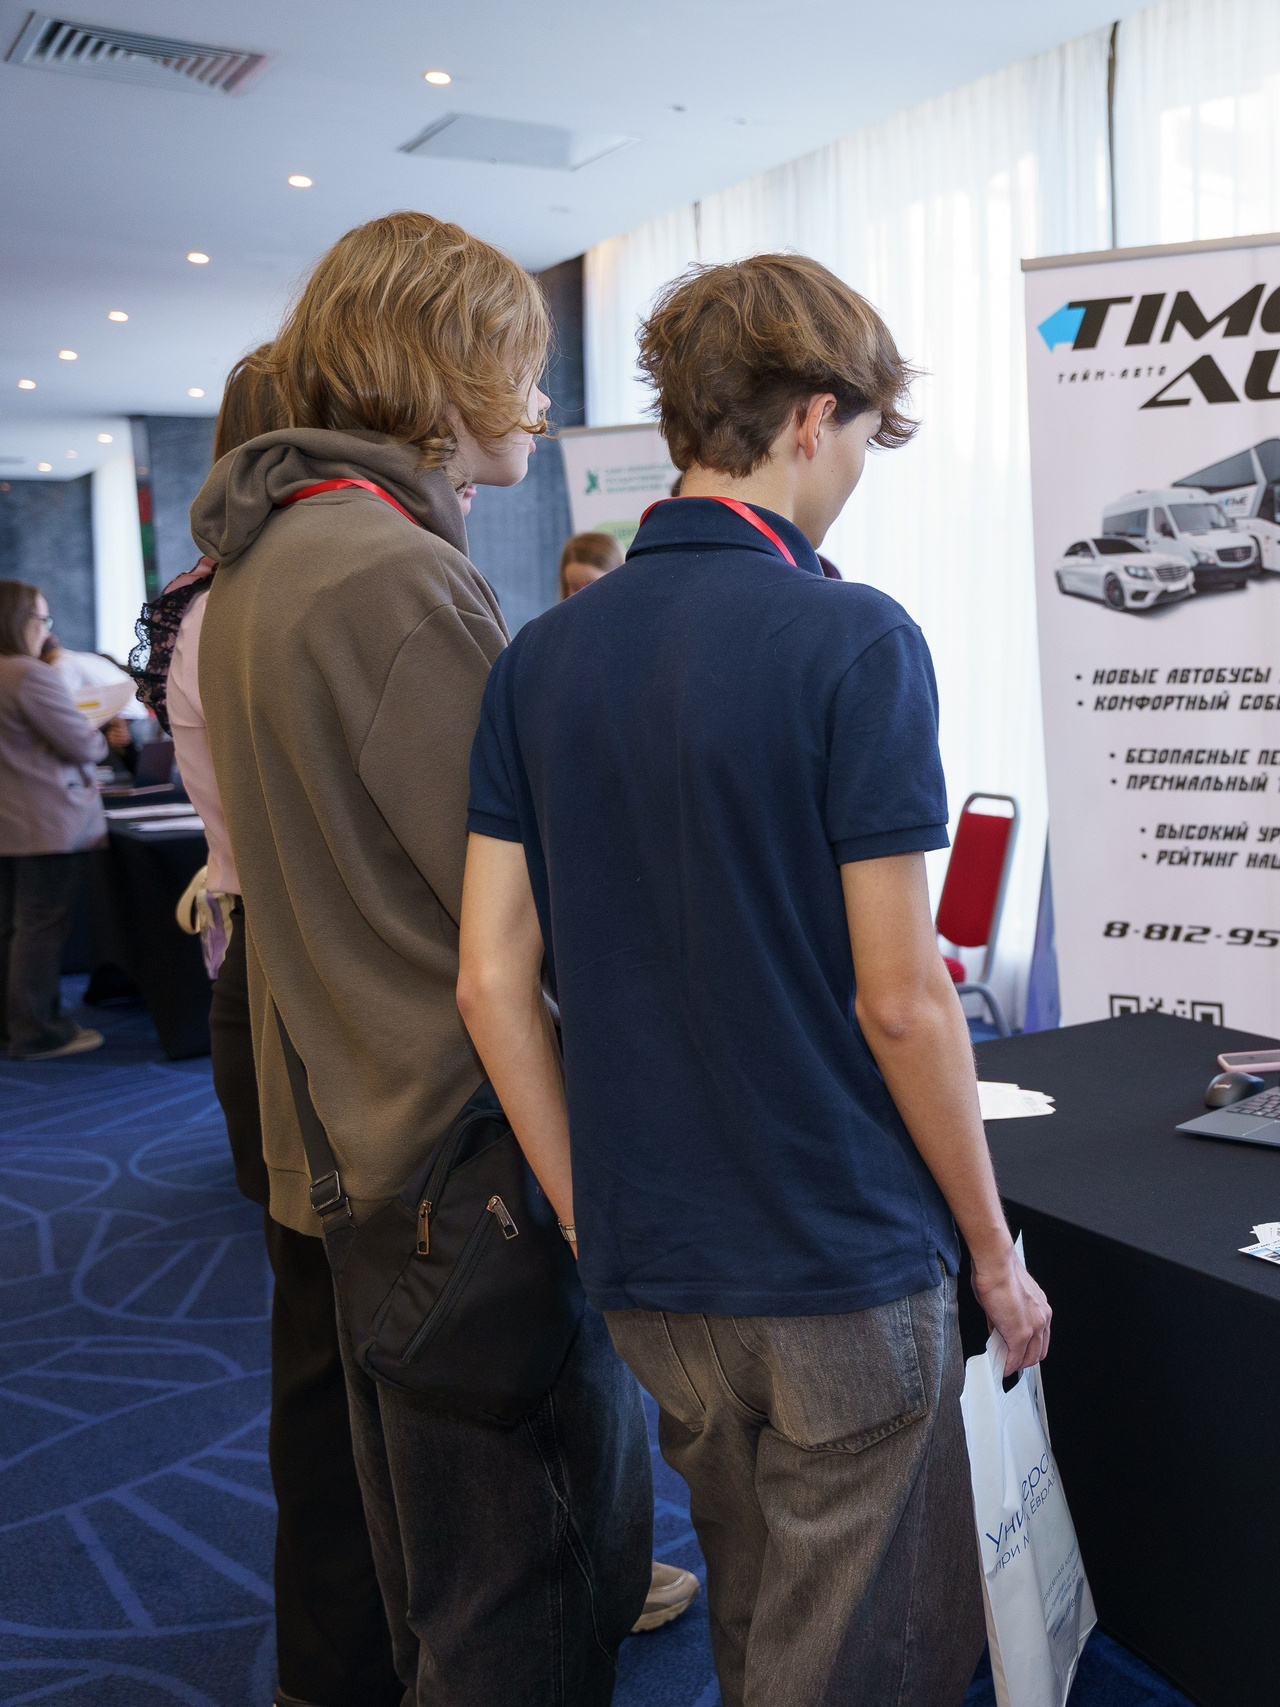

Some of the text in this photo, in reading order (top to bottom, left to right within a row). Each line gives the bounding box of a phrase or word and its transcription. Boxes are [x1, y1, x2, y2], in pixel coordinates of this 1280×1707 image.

[1058, 365, 1166, 384] ТАЙМ-АВТО
[1092, 667, 1159, 685] НОВЫЕ
[1166, 667, 1272, 684] АВТОБУСЫ
[1093, 690, 1230, 711] КОМФОРТНЫЙ
[1124, 747, 1250, 766] БЕЗОПАСНЫЕ
[1126, 772, 1268, 793] ПРЕМИАЛЬНЫЙ
[1155, 821, 1249, 841] ВЫСОКИЙ
[1156, 846, 1239, 868] РЕЙТИНГ
